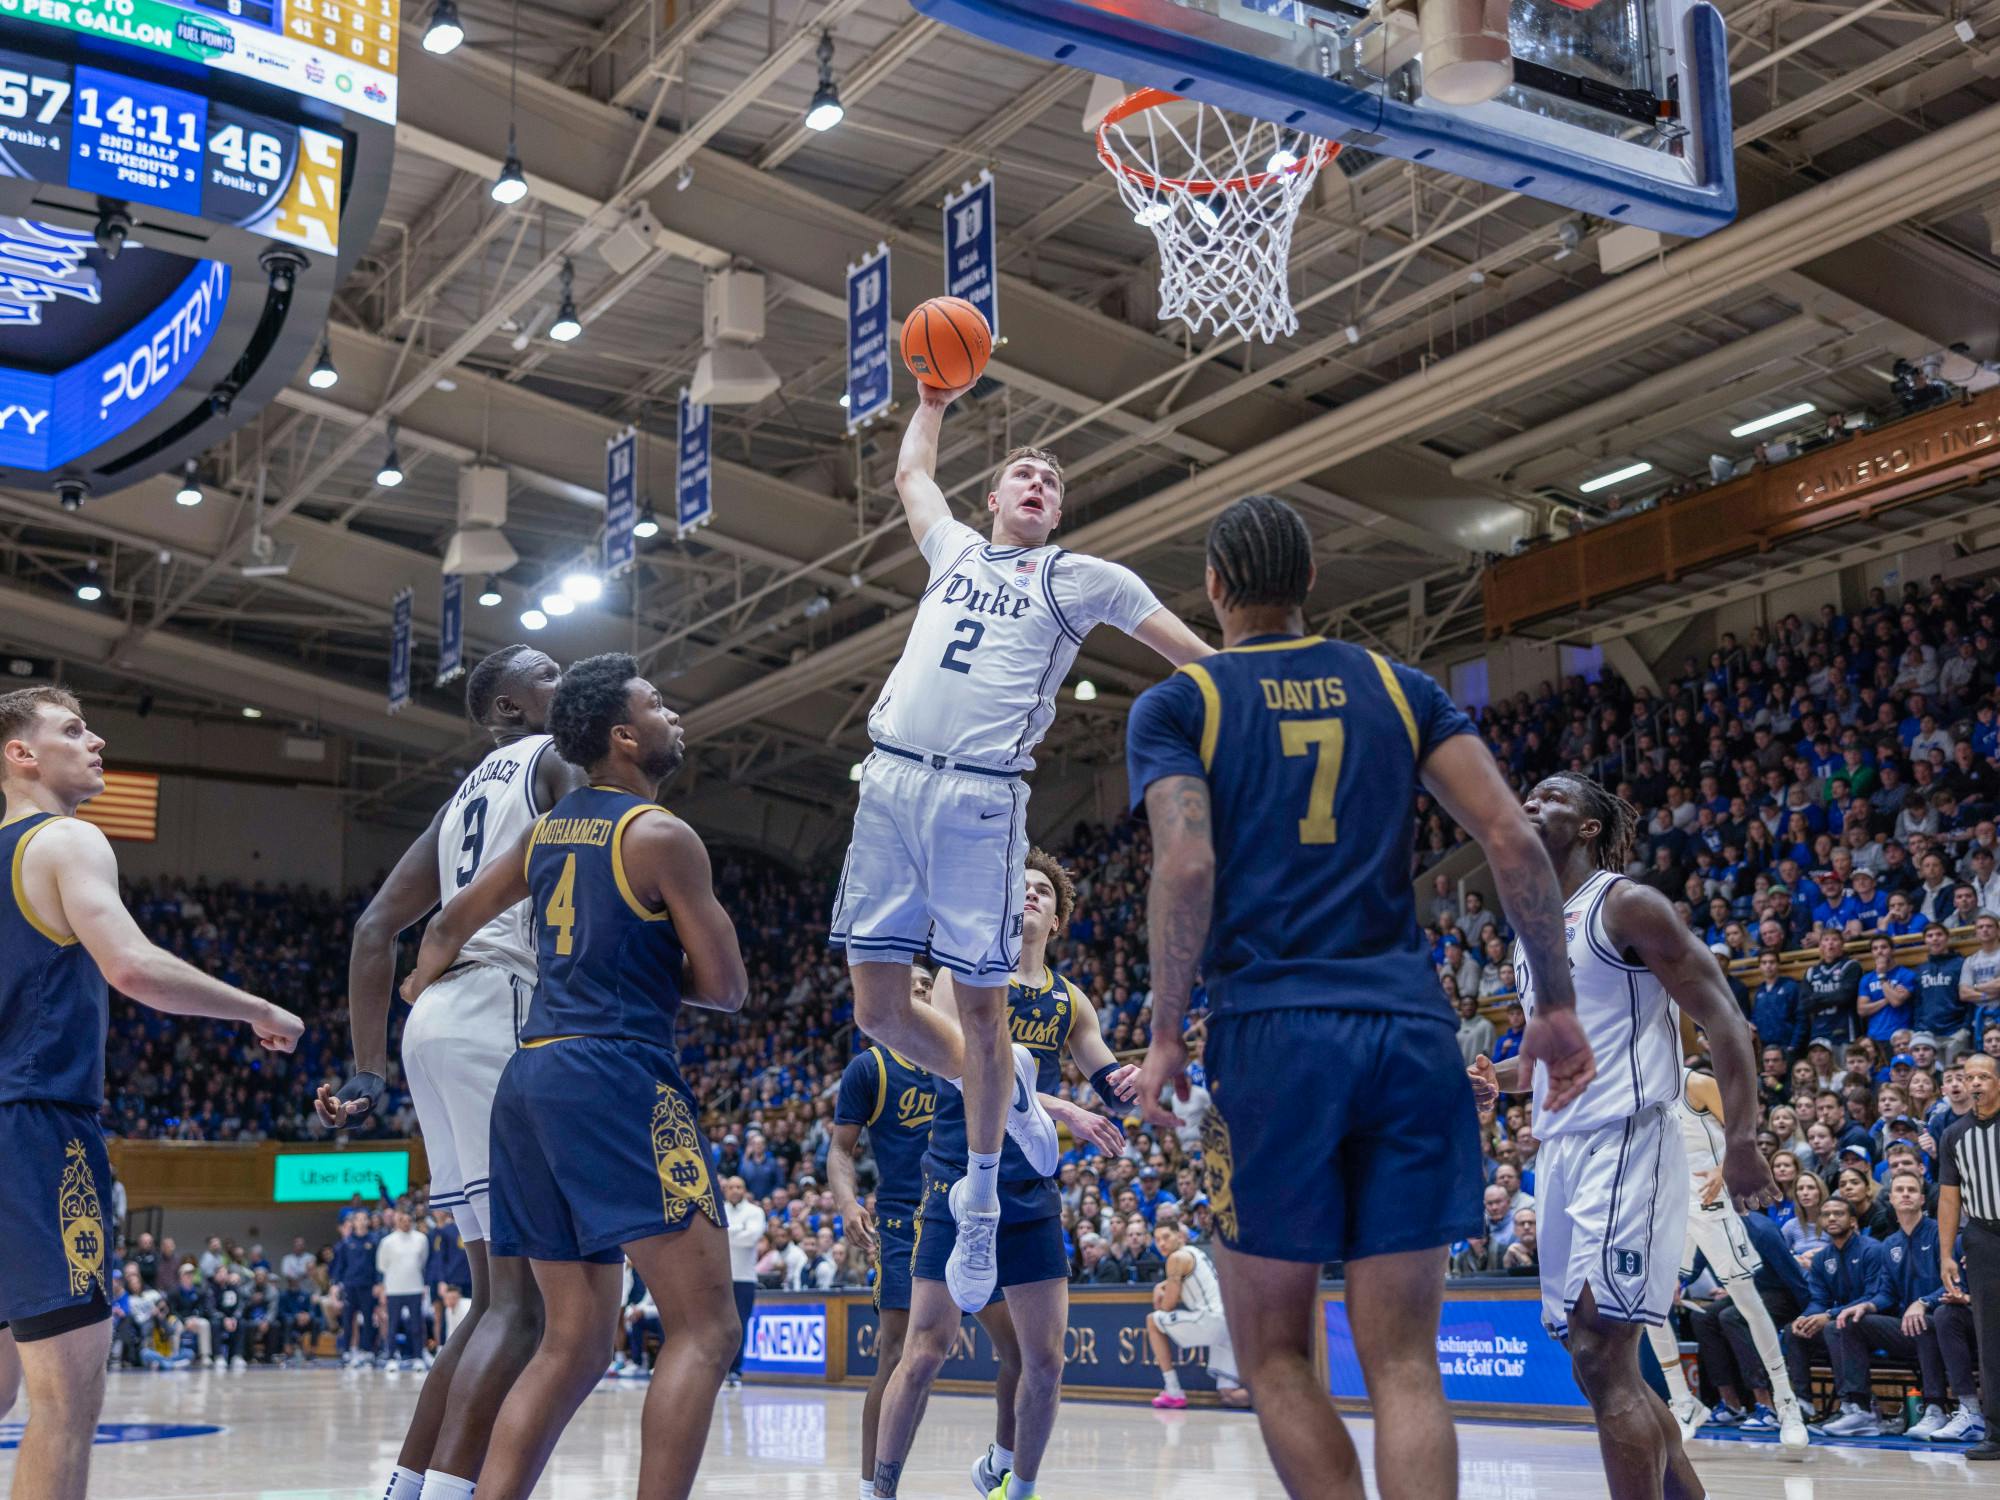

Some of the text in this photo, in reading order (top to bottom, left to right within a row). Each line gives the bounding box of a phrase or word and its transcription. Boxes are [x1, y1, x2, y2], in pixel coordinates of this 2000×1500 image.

[23, 0, 71, 23] PER
[75, 8, 172, 48] GALLON
[178, 23, 200, 40] FUEL
[201, 31, 234, 52] POINTS
[0, 69, 71, 124] 57
[78, 88, 200, 152] 14:11
[48, 136, 60, 151] 4
[99, 133, 179, 161] 2ND HALF
[209, 124, 281, 180] 46
[79, 144, 195, 182] 3 TIMEOUTS 3
[117, 167, 157, 188] POSS
[212, 170, 257, 194] Fouls:
[1796, 416, 2000, 503] CAMERON IND
[942, 573, 1031, 619] Duke
[940, 619, 986, 674] 2
[1260, 677, 1347, 710] DAVIS
[1279, 718, 1345, 844] 7
[456, 795, 488, 888] 9
[535, 819, 613, 846] MOHAMMED
[546, 853, 576, 955] 4
[1920, 972, 1951, 988] Duke
[301, 1168, 338, 1184] Uber
[764, 1321, 821, 1355] NEWS
[1436, 1336, 1528, 1357] ashington Duke
[1455, 1359, 1466, 1375] &
[1467, 1358, 1492, 1376] Golf
